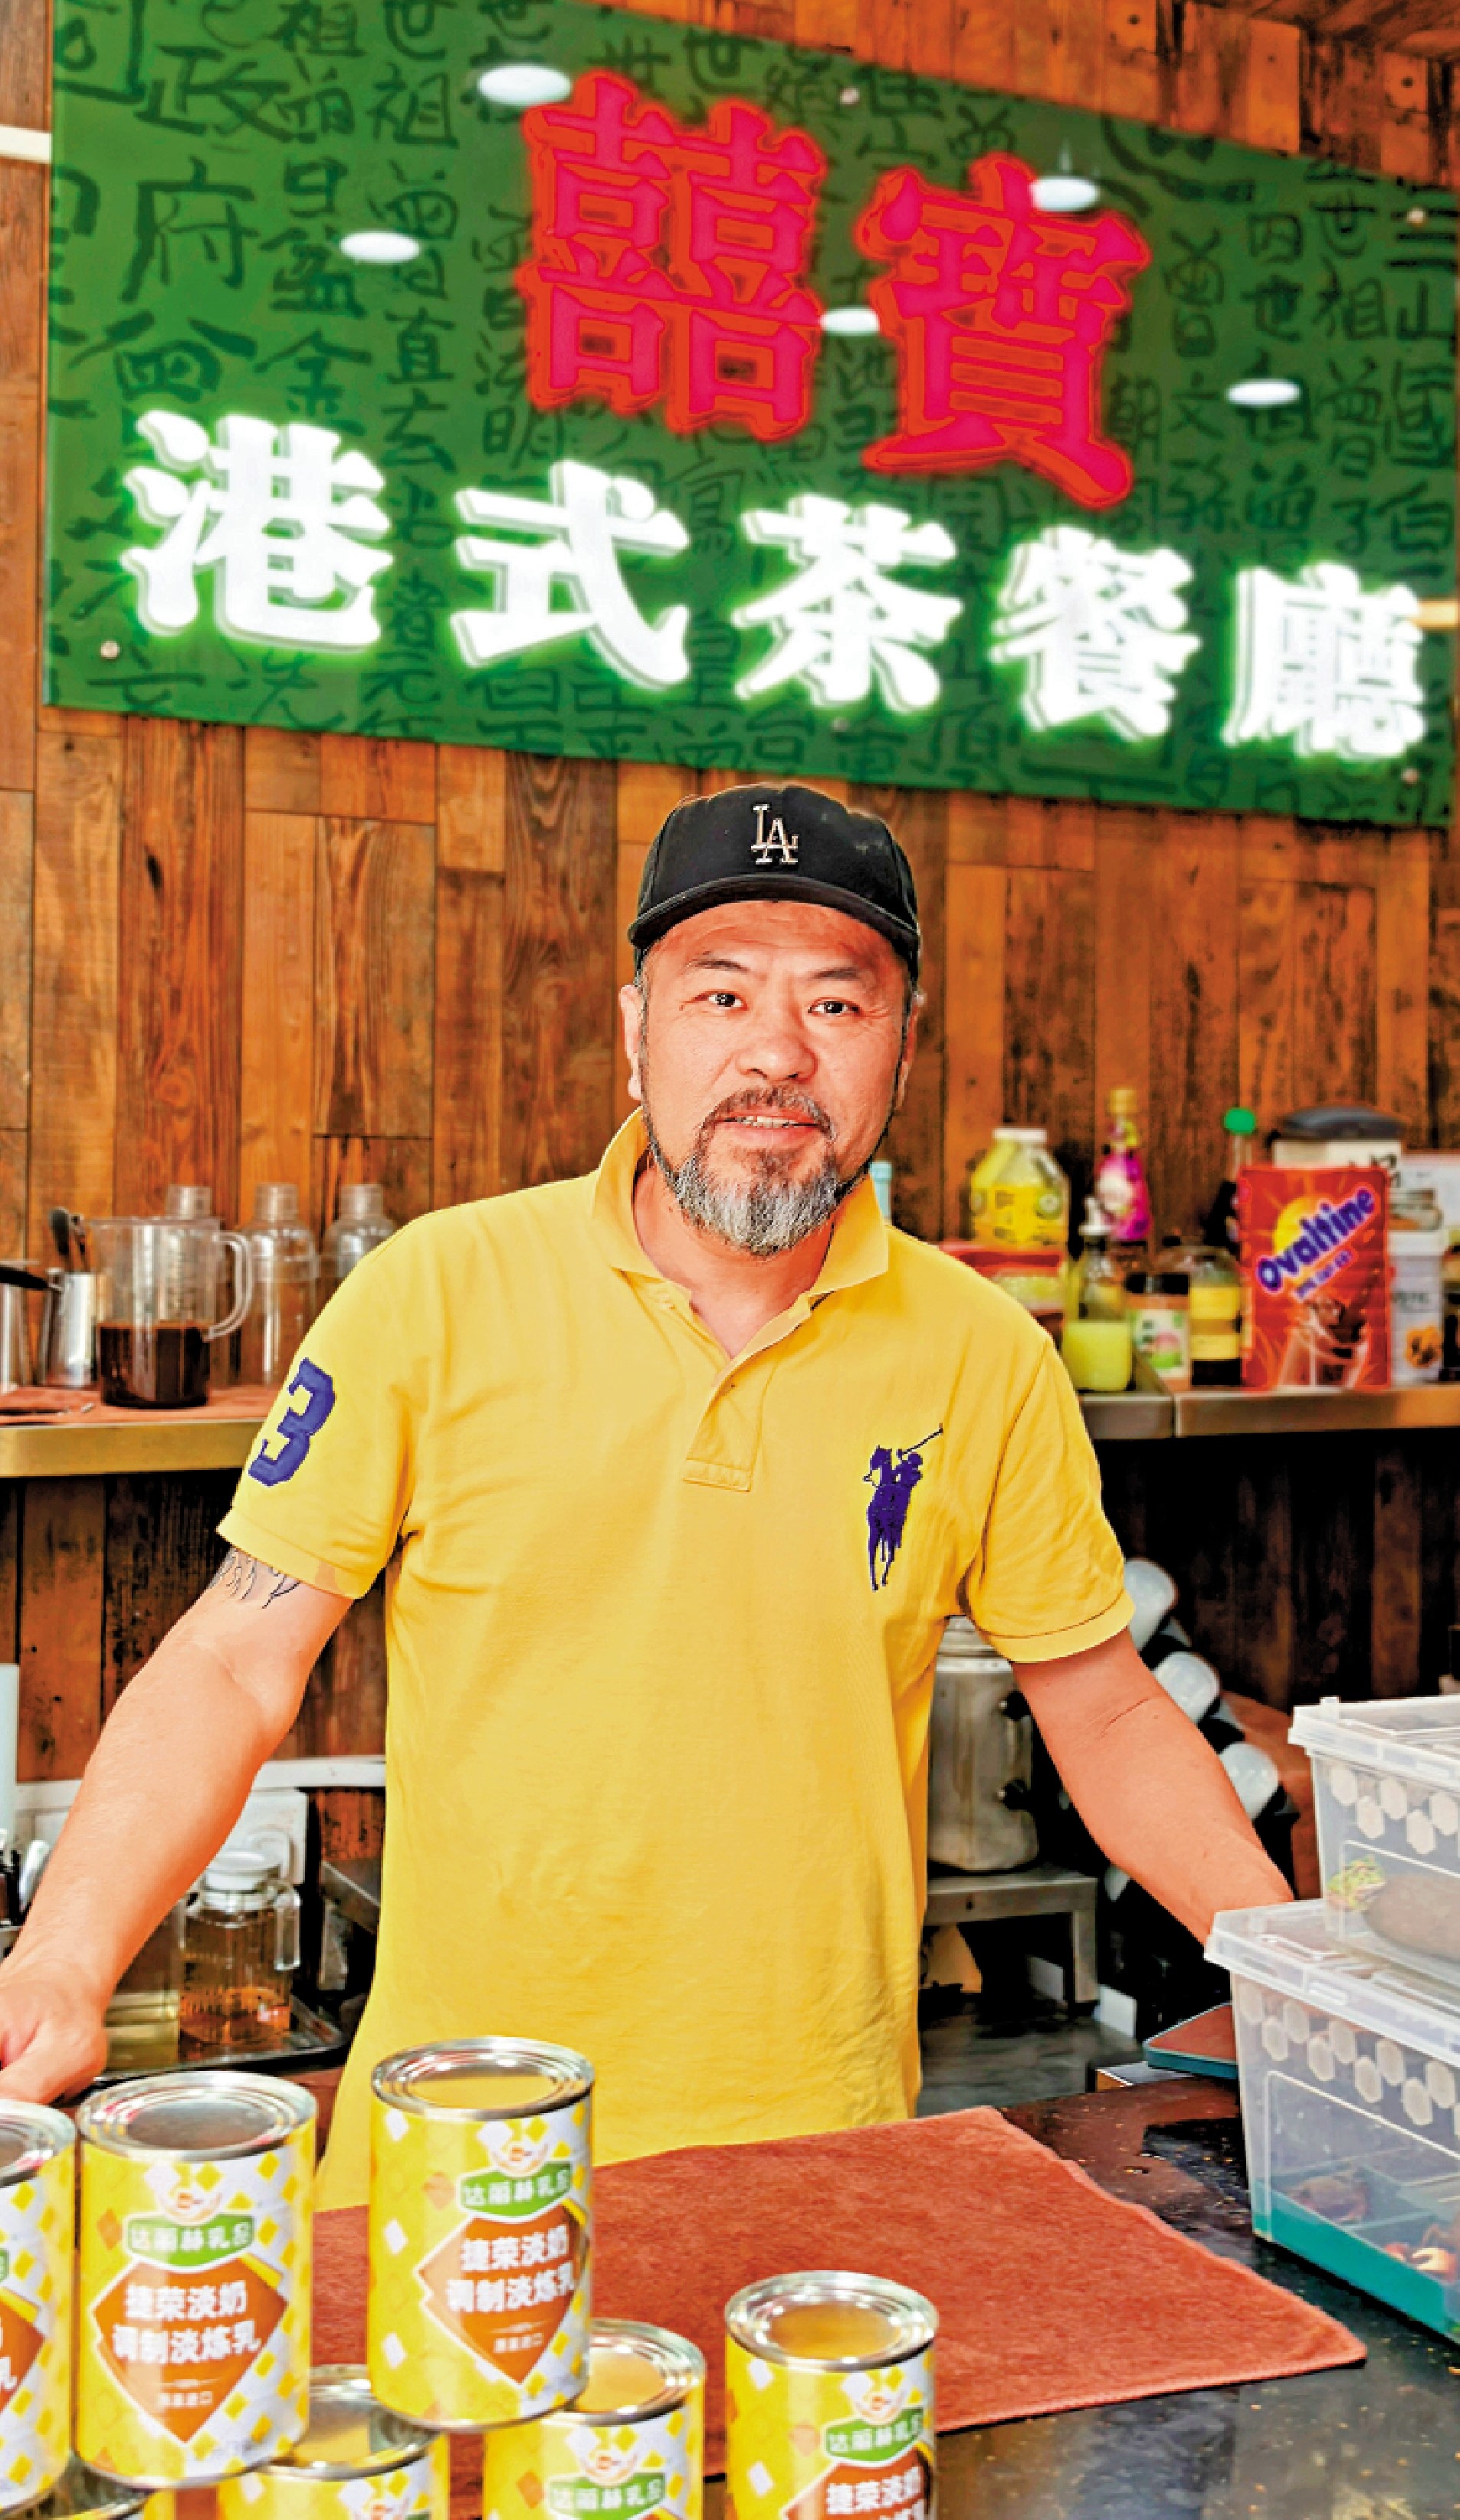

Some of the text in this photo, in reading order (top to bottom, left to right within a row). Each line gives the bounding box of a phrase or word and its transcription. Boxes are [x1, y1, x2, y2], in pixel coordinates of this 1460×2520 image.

[119, 410, 1426, 760] 港式茶餐廳
[751, 804, 799, 865] LA
[1258, 1187, 1375, 1292] Ovaltine
[248, 1357, 336, 1488] 3
